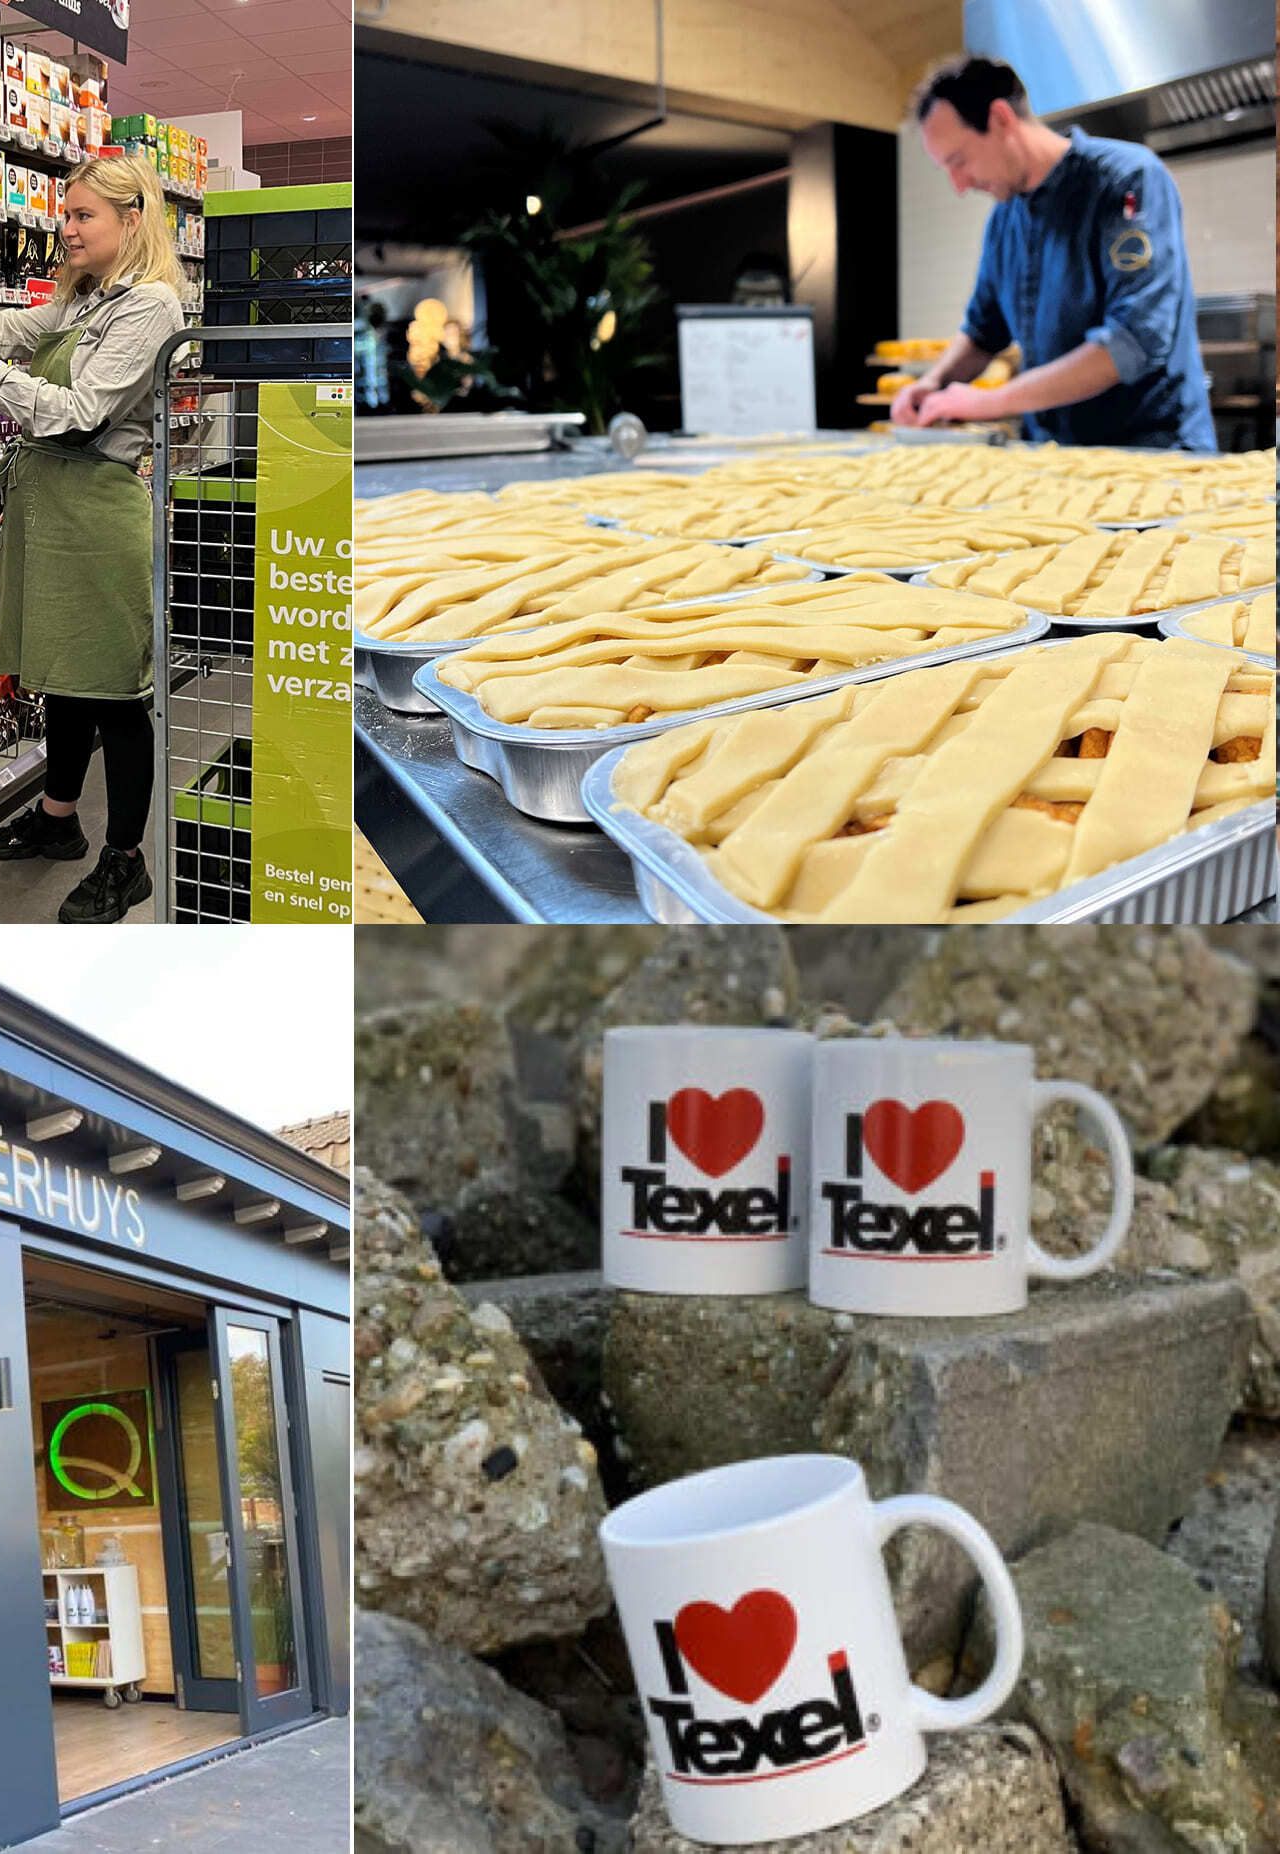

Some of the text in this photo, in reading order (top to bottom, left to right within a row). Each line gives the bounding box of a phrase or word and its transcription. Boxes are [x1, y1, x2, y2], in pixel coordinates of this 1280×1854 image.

[270, 529, 325, 558] Uw
[269, 563, 352, 595] beste
[267, 604, 352, 631] word
[268, 639, 330, 665] met
[267, 673, 352, 702] verza
[265, 863, 314, 885] Bestel
[264, 889, 351, 919] en snel op
[49, 1402, 145, 1500] Q
[647, 1649, 866, 1776] Texel
